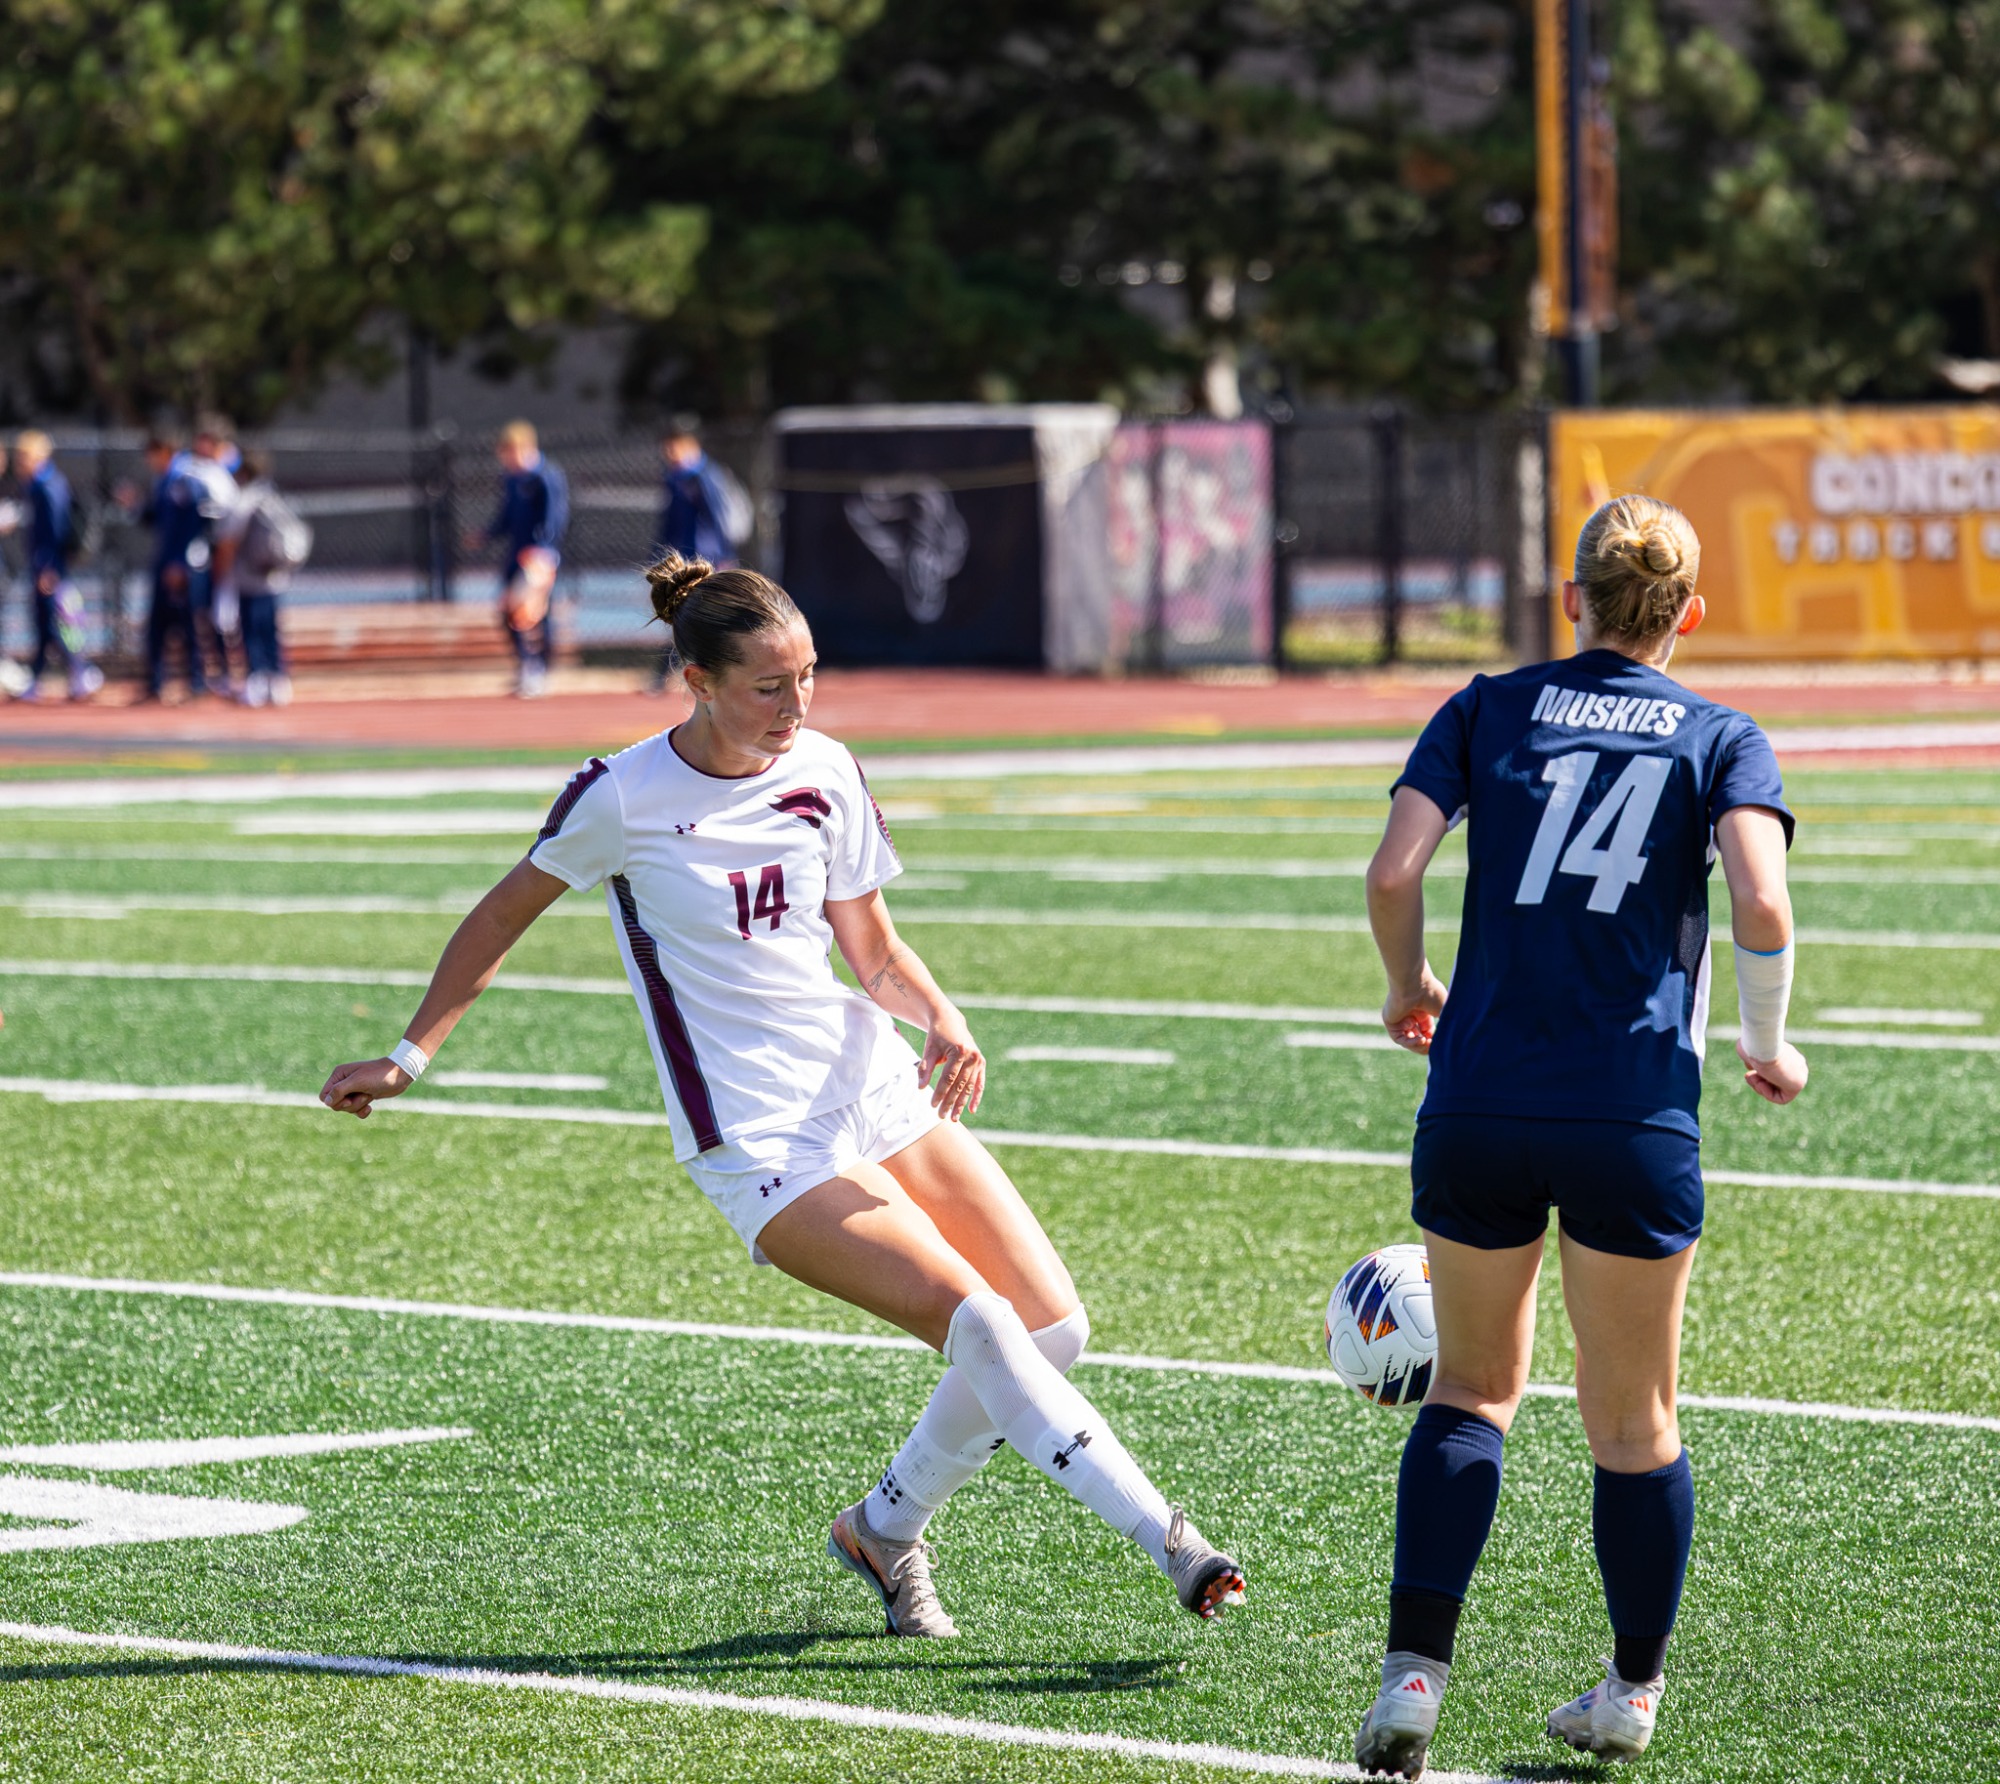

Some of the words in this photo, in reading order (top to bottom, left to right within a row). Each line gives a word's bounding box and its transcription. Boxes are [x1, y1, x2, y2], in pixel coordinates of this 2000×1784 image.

[1531, 684, 1687, 736] MUSKIES
[1515, 751, 1674, 914] 14
[727, 863, 790, 941] 14
